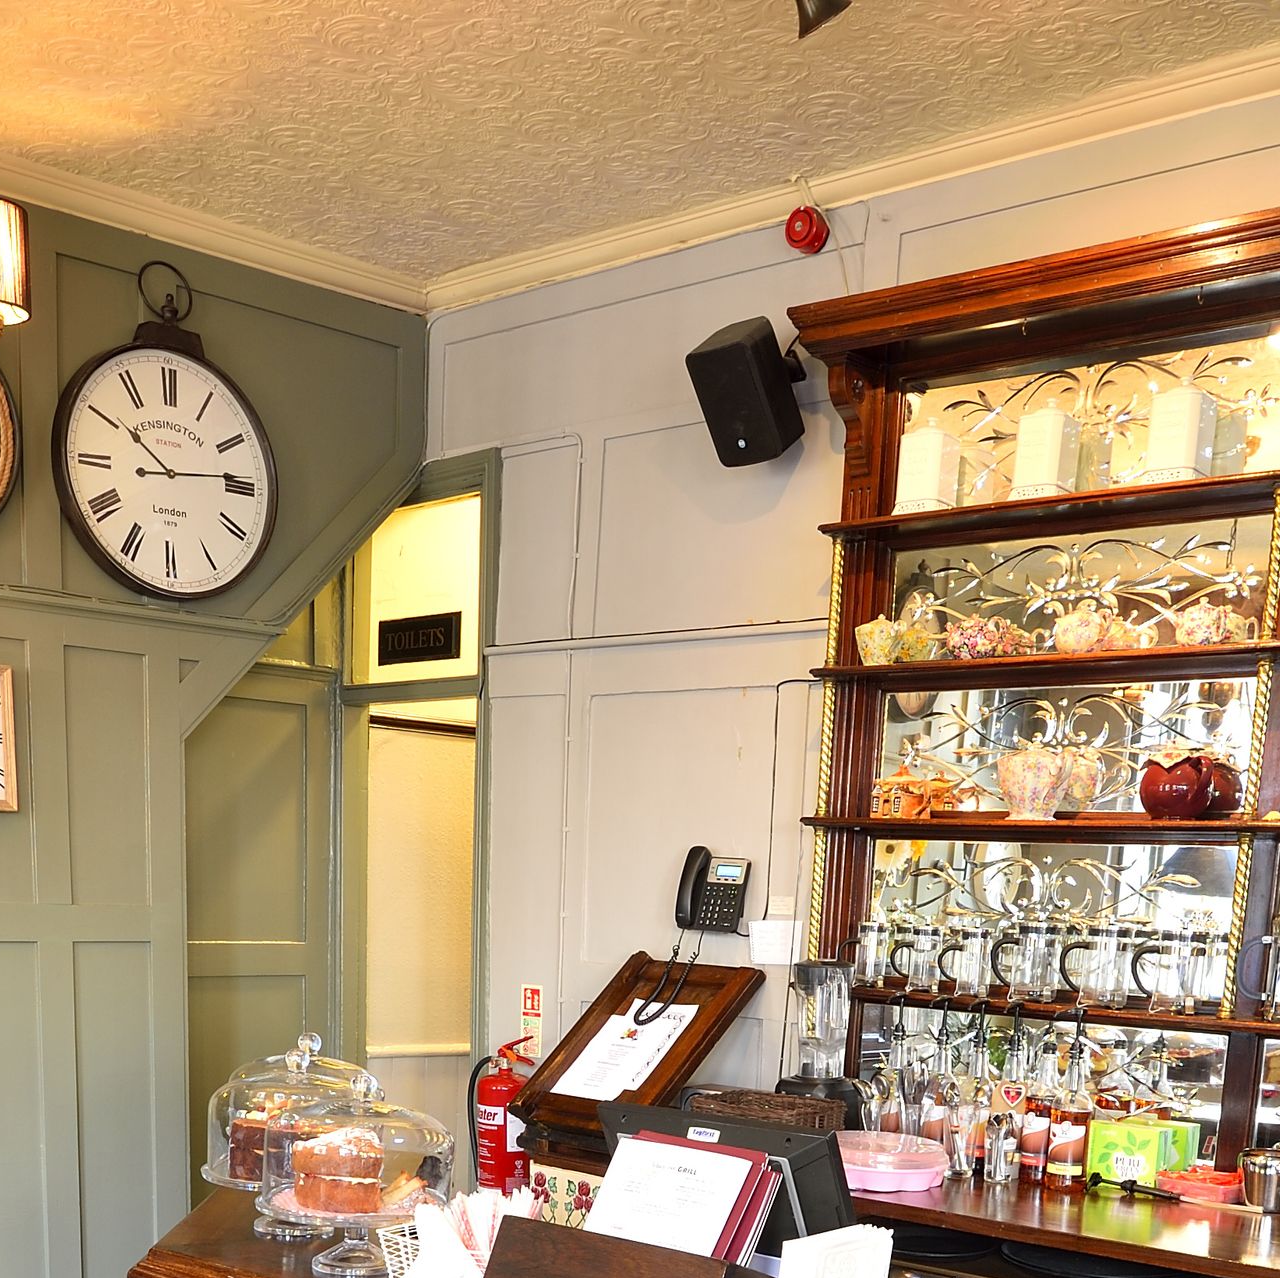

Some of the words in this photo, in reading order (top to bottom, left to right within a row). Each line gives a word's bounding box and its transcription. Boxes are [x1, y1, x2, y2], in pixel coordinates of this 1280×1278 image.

[132, 420, 204, 448] KENSINGTON
[155, 439, 182, 448] STATION
[152, 504, 187, 518] London
[385, 627, 444, 651] TOILETS
[478, 1108, 499, 1122] ater
